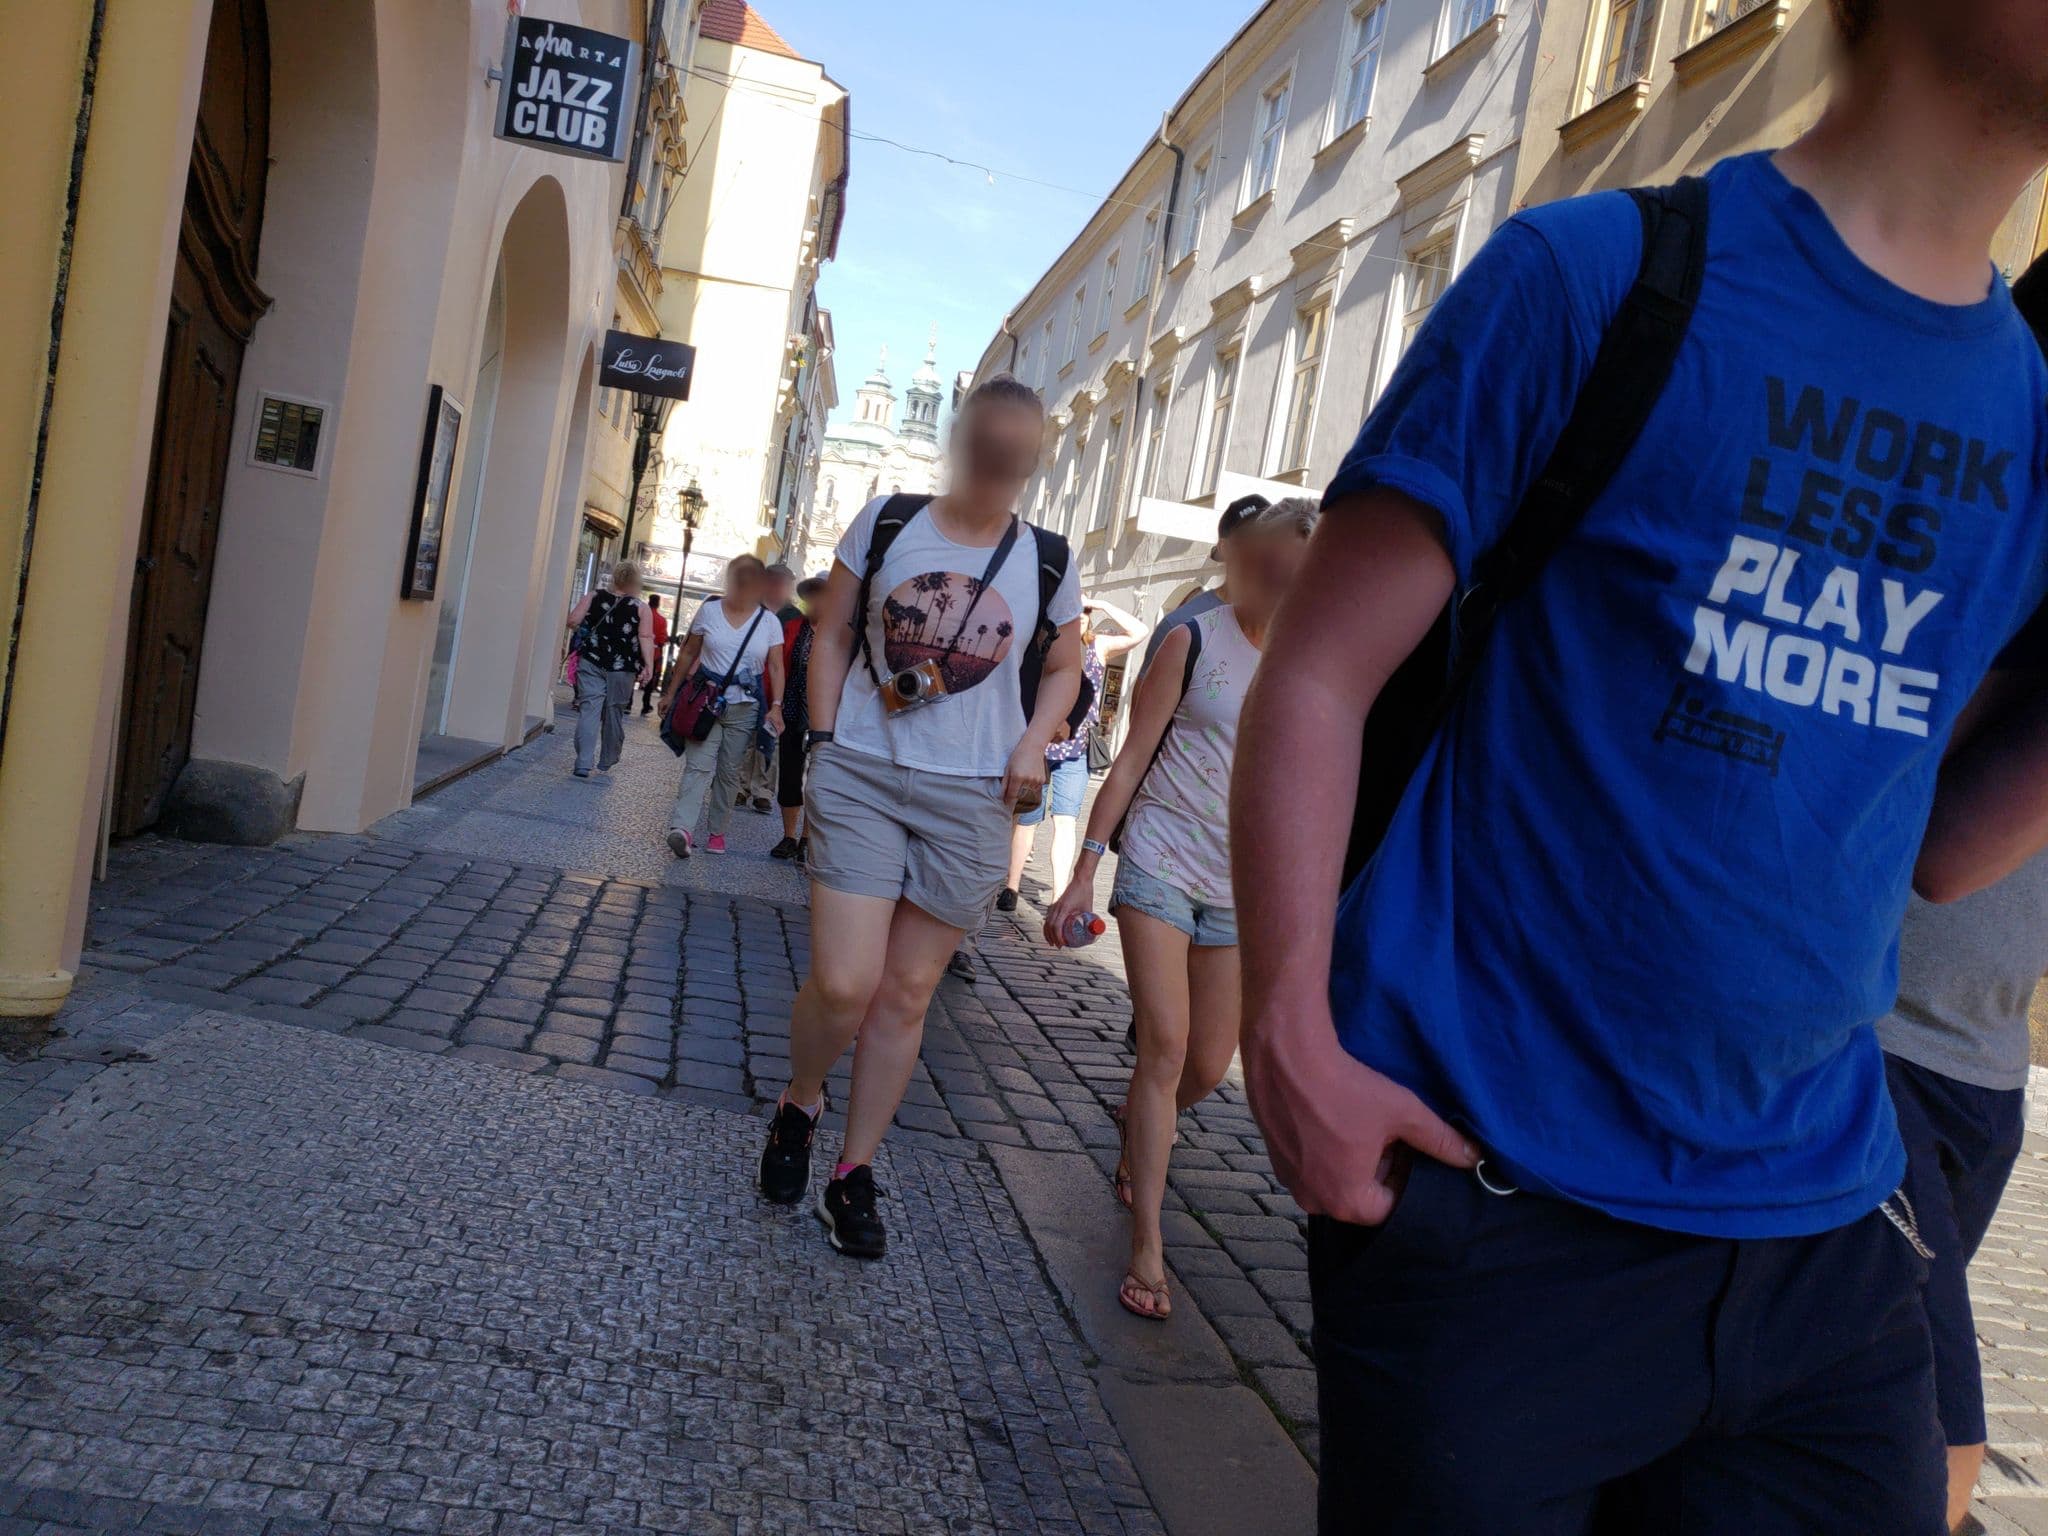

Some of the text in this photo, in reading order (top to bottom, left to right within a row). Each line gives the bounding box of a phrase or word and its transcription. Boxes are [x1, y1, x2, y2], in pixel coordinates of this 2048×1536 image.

[512, 100, 607, 149] CLUB
[516, 65, 613, 115] JAZZ
[607, 348, 643, 374] Luisa
[1764, 375, 2016, 512] WORK
[1739, 456, 1942, 573] LESS
[1706, 533, 1945, 656] PLAY
[1683, 605, 1939, 738] MORE
